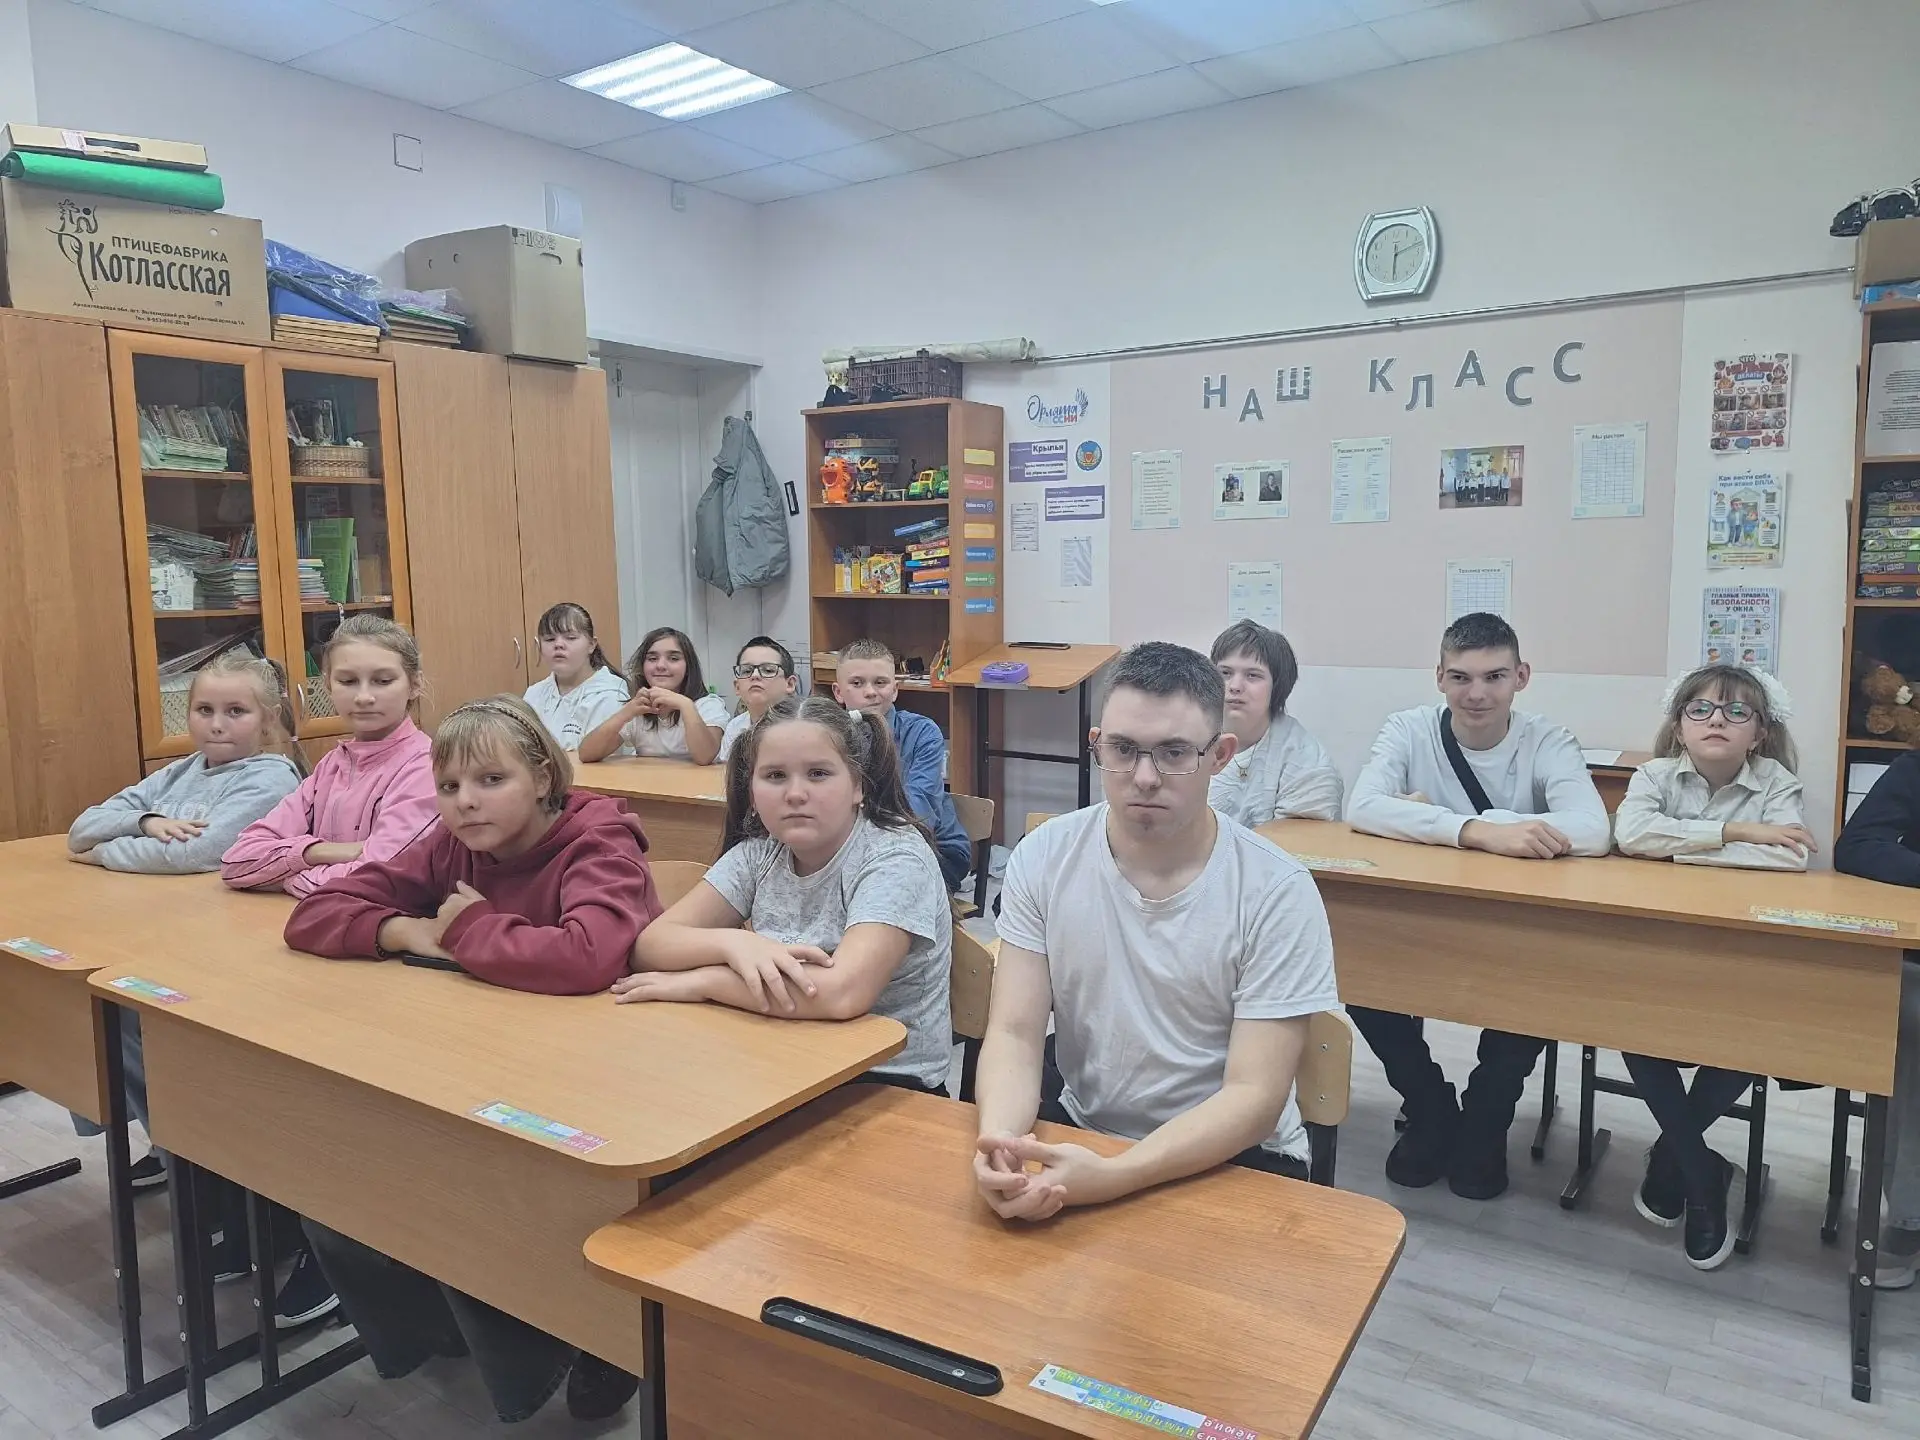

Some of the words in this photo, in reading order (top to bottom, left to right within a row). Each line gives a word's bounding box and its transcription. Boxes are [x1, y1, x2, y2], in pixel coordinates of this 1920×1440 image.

[90, 242, 230, 296] Котласская
[112, 236, 228, 263] ПТИЦЕФАБРИКА
[1203, 366, 1310, 422] НАШ
[1368, 341, 1584, 412] КЛАСС
[1032, 444, 1064, 454] Крылья
